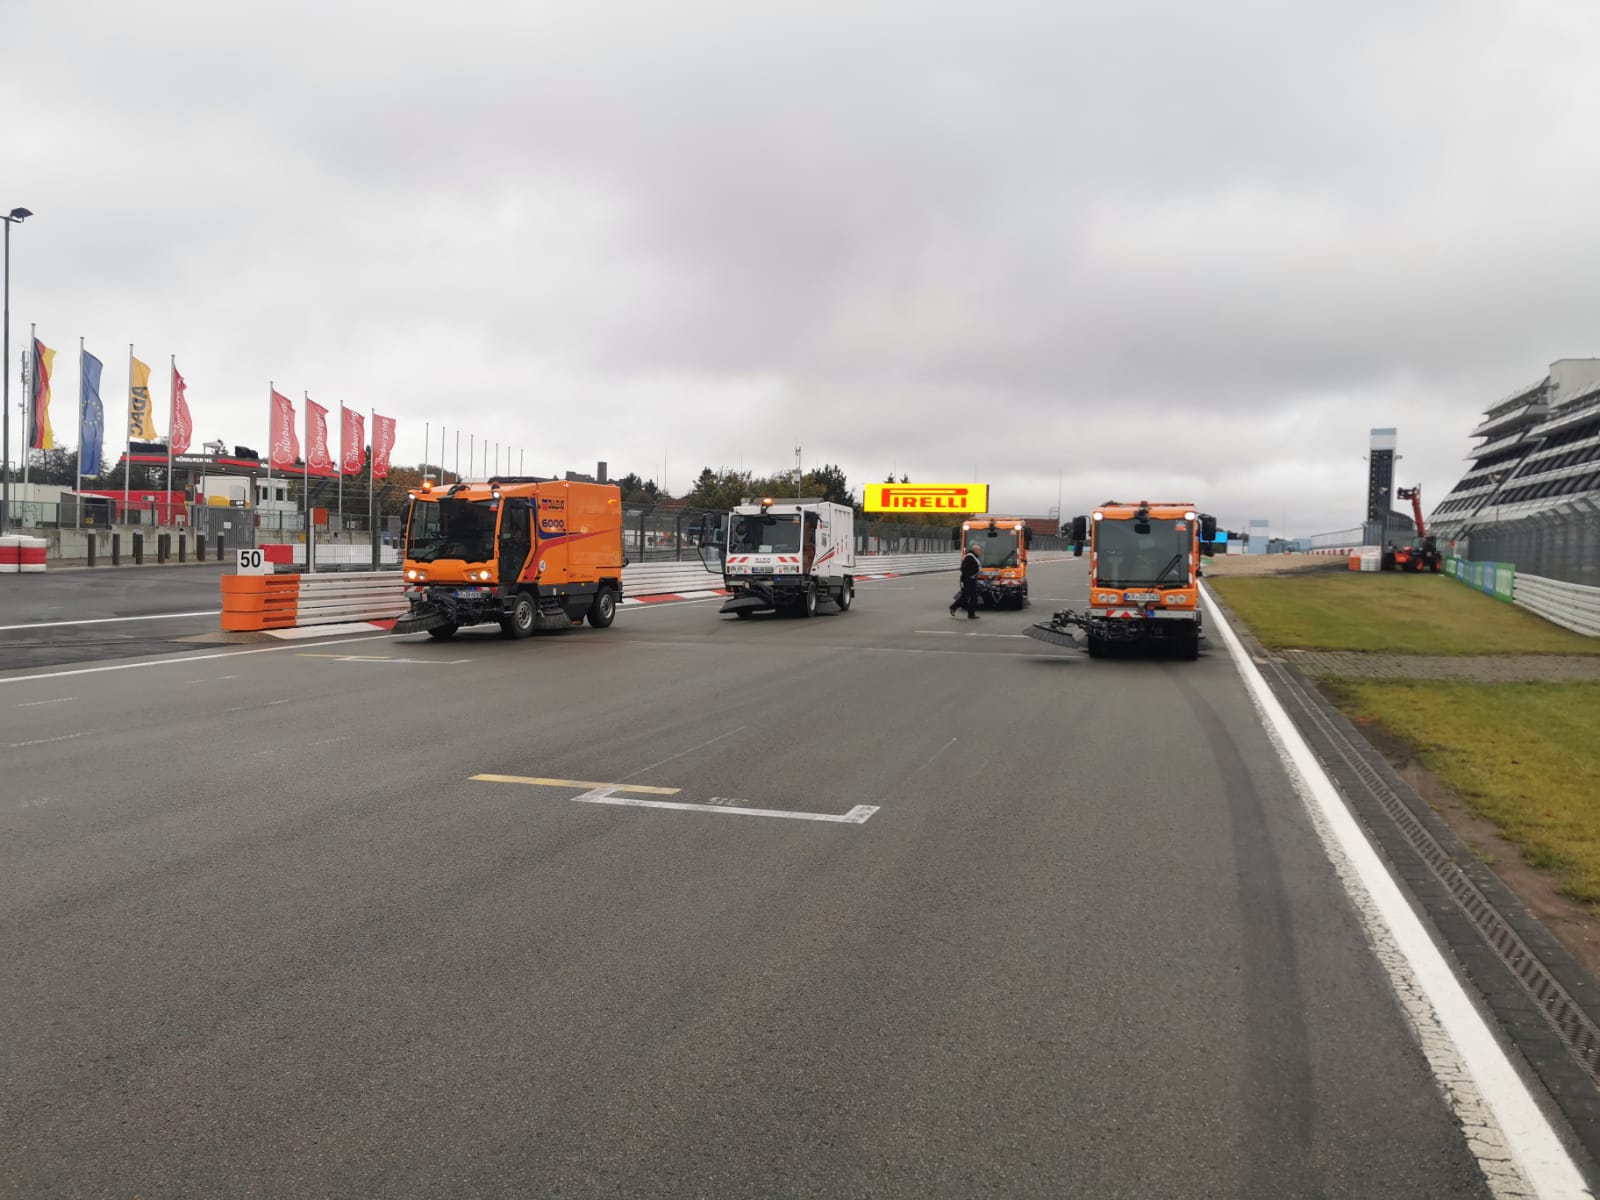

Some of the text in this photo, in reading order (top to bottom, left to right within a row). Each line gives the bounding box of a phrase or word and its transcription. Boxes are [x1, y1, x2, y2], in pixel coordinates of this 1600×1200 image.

[129, 386, 148, 436] ADAC
[881, 488, 968, 508] PIRELLI
[541, 519, 564, 528] 6000
[240, 551, 261, 568] 50
